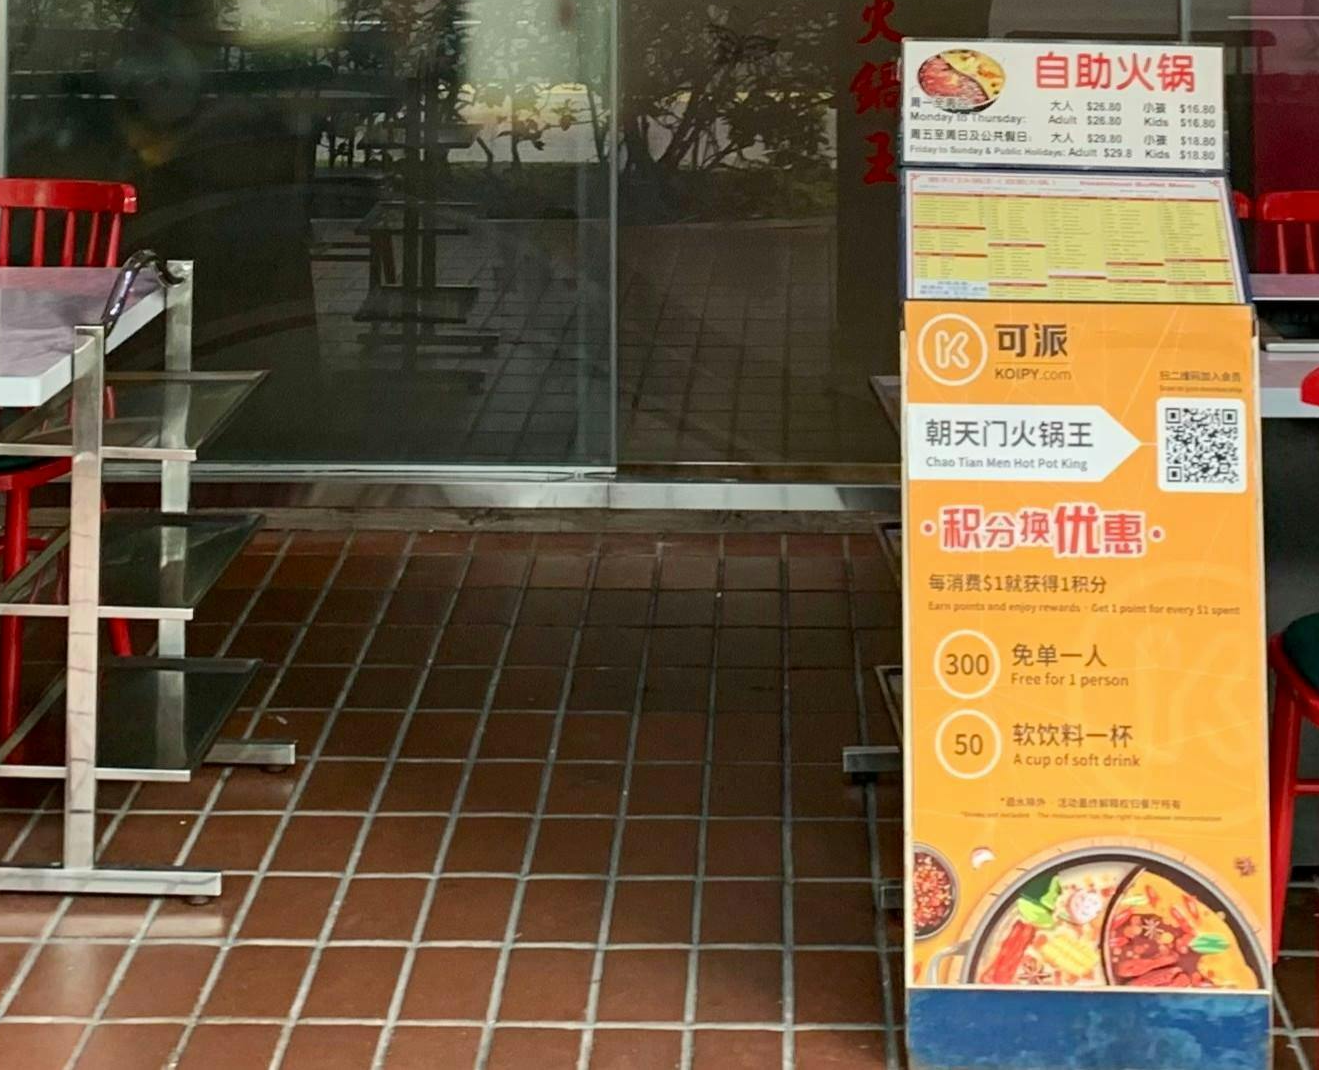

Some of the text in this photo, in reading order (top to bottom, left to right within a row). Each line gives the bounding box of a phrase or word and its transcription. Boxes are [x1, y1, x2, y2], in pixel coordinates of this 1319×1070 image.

[1035, 51, 1196, 94] 自助火锅
[1050, 100, 1073, 112] 大人
[910, 112, 953, 125] Monday
[957, 112, 967, 123] to
[1048, 115, 1077, 126] Adult
[1144, 116, 1169, 128] Kids
[1050, 132, 1074, 144] 大人
[1145, 149, 1170, 160] Kids
[993, 322, 1069, 359] 可派
[994, 368, 1072, 381] KOIPY.com
[925, 419, 1095, 449] 朝天门火锅王
[926, 456, 1088, 472] Chao Tian Men Hot Pot King
[941, 505, 1145, 556] 积分换优惠
[928, 573, 1108, 595] 每消费$1就获得1积分
[928, 601, 951, 611] Earn
[953, 601, 985, 613] points
[987, 601, 1006, 612] and
[1008, 602, 1037, 614] enjoy
[1091, 603, 1109, 613] Get
[1119, 604, 1147, 615] point
[1149, 603, 1164, 614] for
[1166, 605, 1195, 617] every
[1211, 606, 1240, 617] spent
[944, 653, 991, 677] 300
[1010, 643, 1108, 668] 免单一人
[1011, 673, 1130, 688] Free for 1 person
[953, 733, 984, 757] 50
[1012, 723, 1134, 748] 软饮料一杯
[1013, 754, 1140, 768] A cup of soft drink
